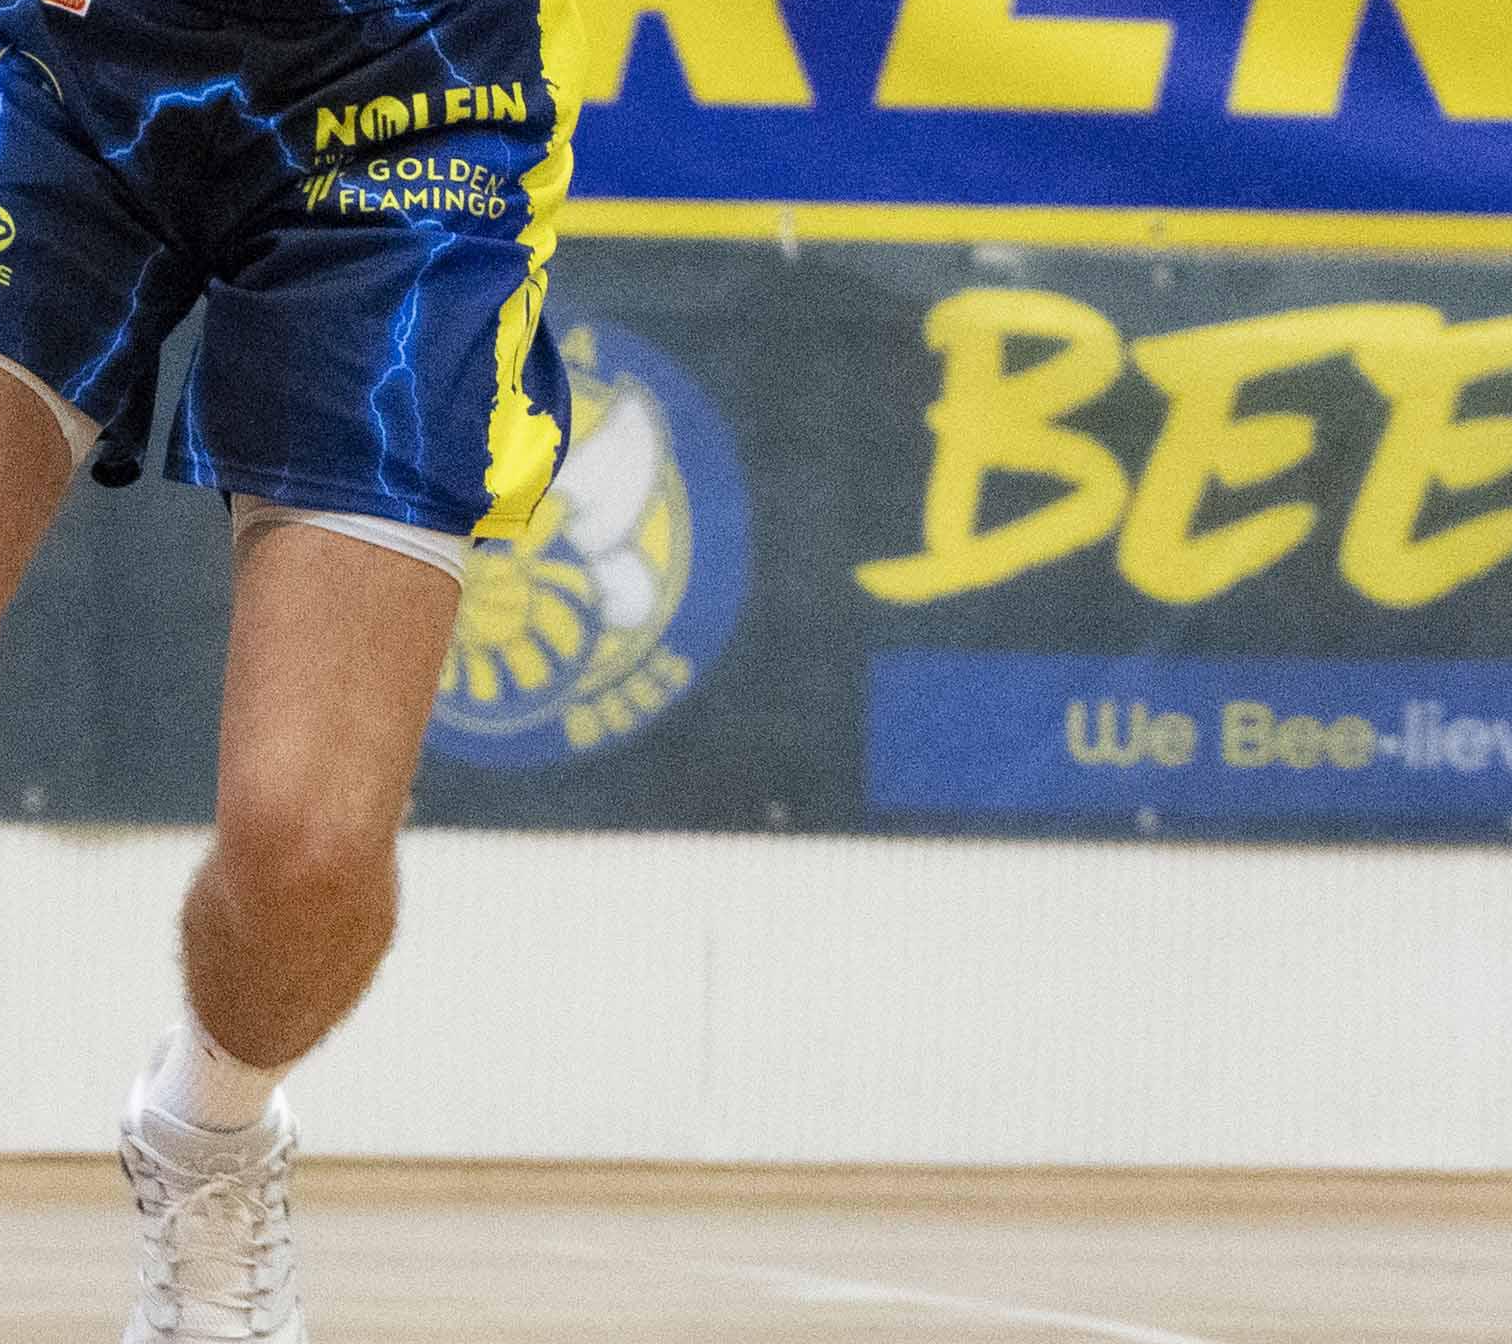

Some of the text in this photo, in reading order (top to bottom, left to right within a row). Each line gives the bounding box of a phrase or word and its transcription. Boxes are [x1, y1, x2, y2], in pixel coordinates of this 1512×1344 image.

[366, 156, 506, 198] GOLDEN
[338, 186, 507, 220] FLAMINGO
[1065, 698, 1197, 768] We
